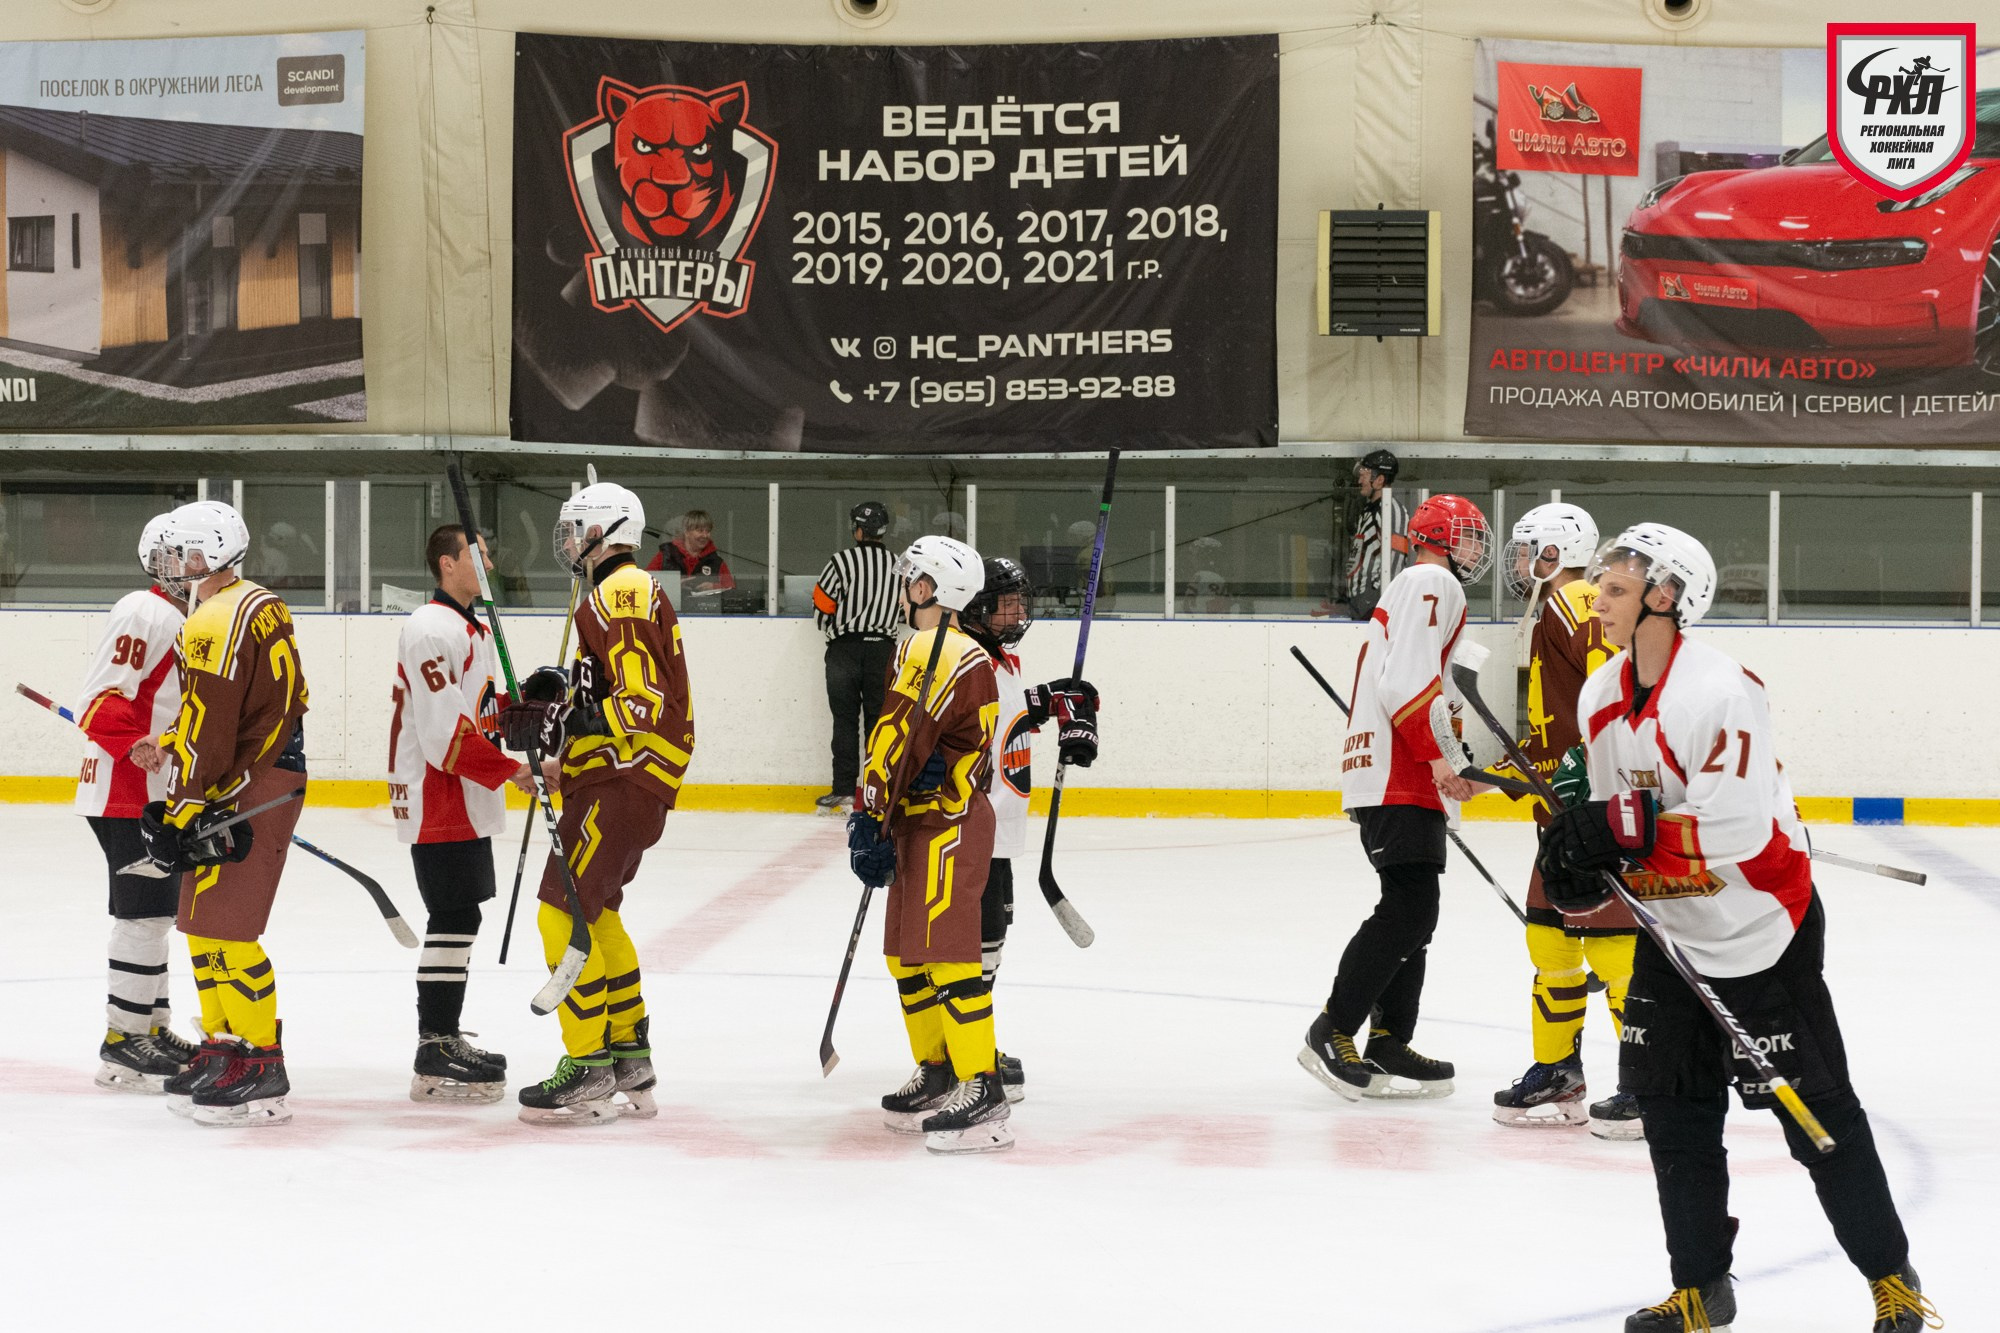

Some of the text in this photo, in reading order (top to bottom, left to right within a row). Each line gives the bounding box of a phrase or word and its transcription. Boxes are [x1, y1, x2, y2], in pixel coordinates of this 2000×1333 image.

[40, 74, 263, 98] ПОСЕЛОК В ОКРУЖЕНИИ ЛЕСА
[283, 83, 339, 96] development
[287, 69, 335, 83] SCANDI
[883, 95, 1121, 145] ВЕДЁТСЯ
[818, 134, 1189, 189] НАБОР ДЕТЕЙ
[792, 204, 1229, 251] 2015, 2016, 2017, 2018,
[620, 246, 714, 263] ХОККЕЙНЫЙ КЛУБ
[791, 251, 889, 291] 2019,
[901, 251, 1011, 291] 2020,
[1023, 249, 1115, 284] 2021
[592, 256, 750, 308] ПАНТЕРЫ
[911, 328, 1173, 363] HC_PANTHERS
[1489, 348, 1877, 380] АВТОЦЕНТР «ЧИЛИ АВТО»
[863, 374, 1176, 409] +7 (965) 853-92-88
[1489, 386, 1603, 409] ПРОДАЖА
[1609, 389, 1784, 411] АВТОМОБИЛЕЙ
[1804, 395, 1893, 414] СЕРВИС
[1672, 559, 1694, 576] CCM
[1423, 594, 1439, 627] 7
[111, 634, 147, 671] 98
[1699, 727, 1751, 780] 21
